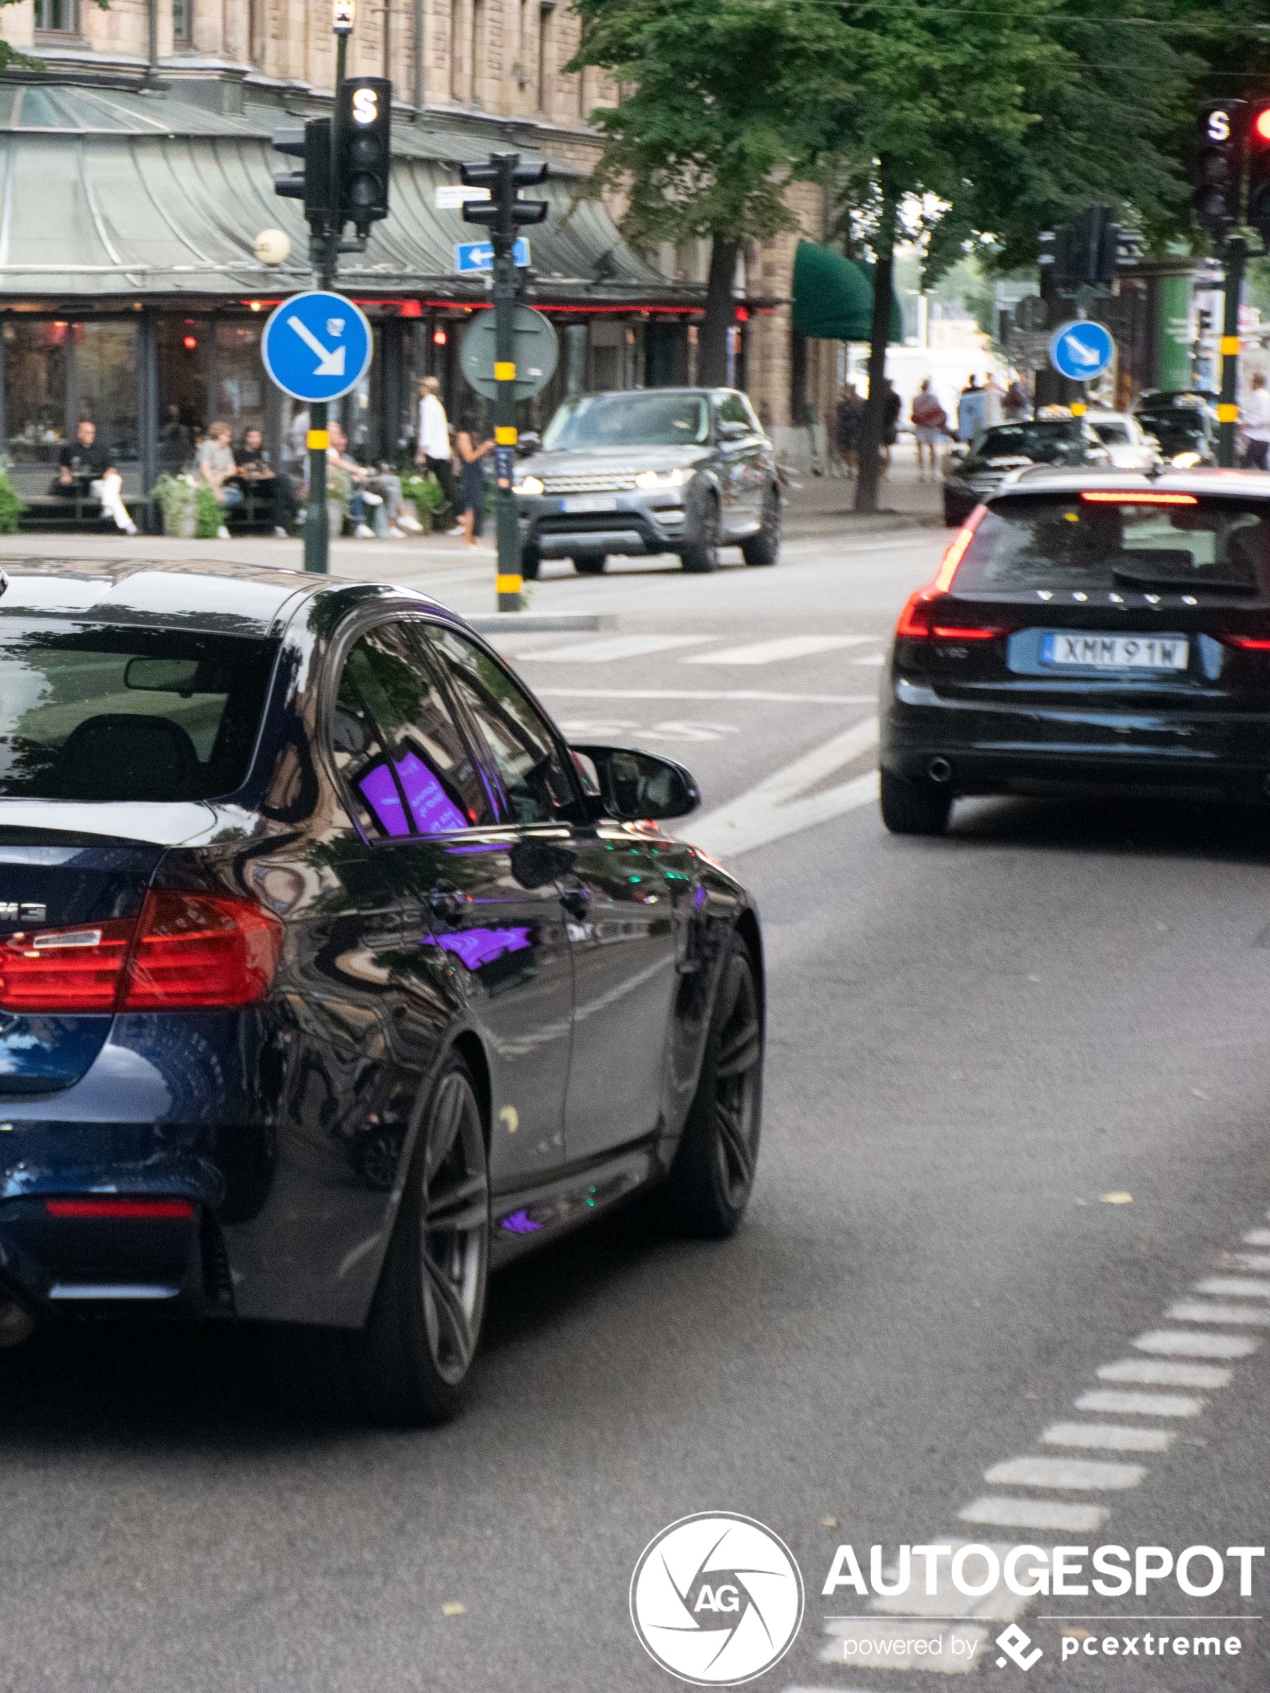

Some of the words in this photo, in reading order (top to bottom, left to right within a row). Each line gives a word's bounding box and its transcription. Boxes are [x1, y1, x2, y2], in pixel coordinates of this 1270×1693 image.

[352, 87, 378, 123] S
[1209, 110, 1231, 141] S
[1036, 589, 1198, 606] VOLVO
[1064, 637, 1117, 664] XMM
